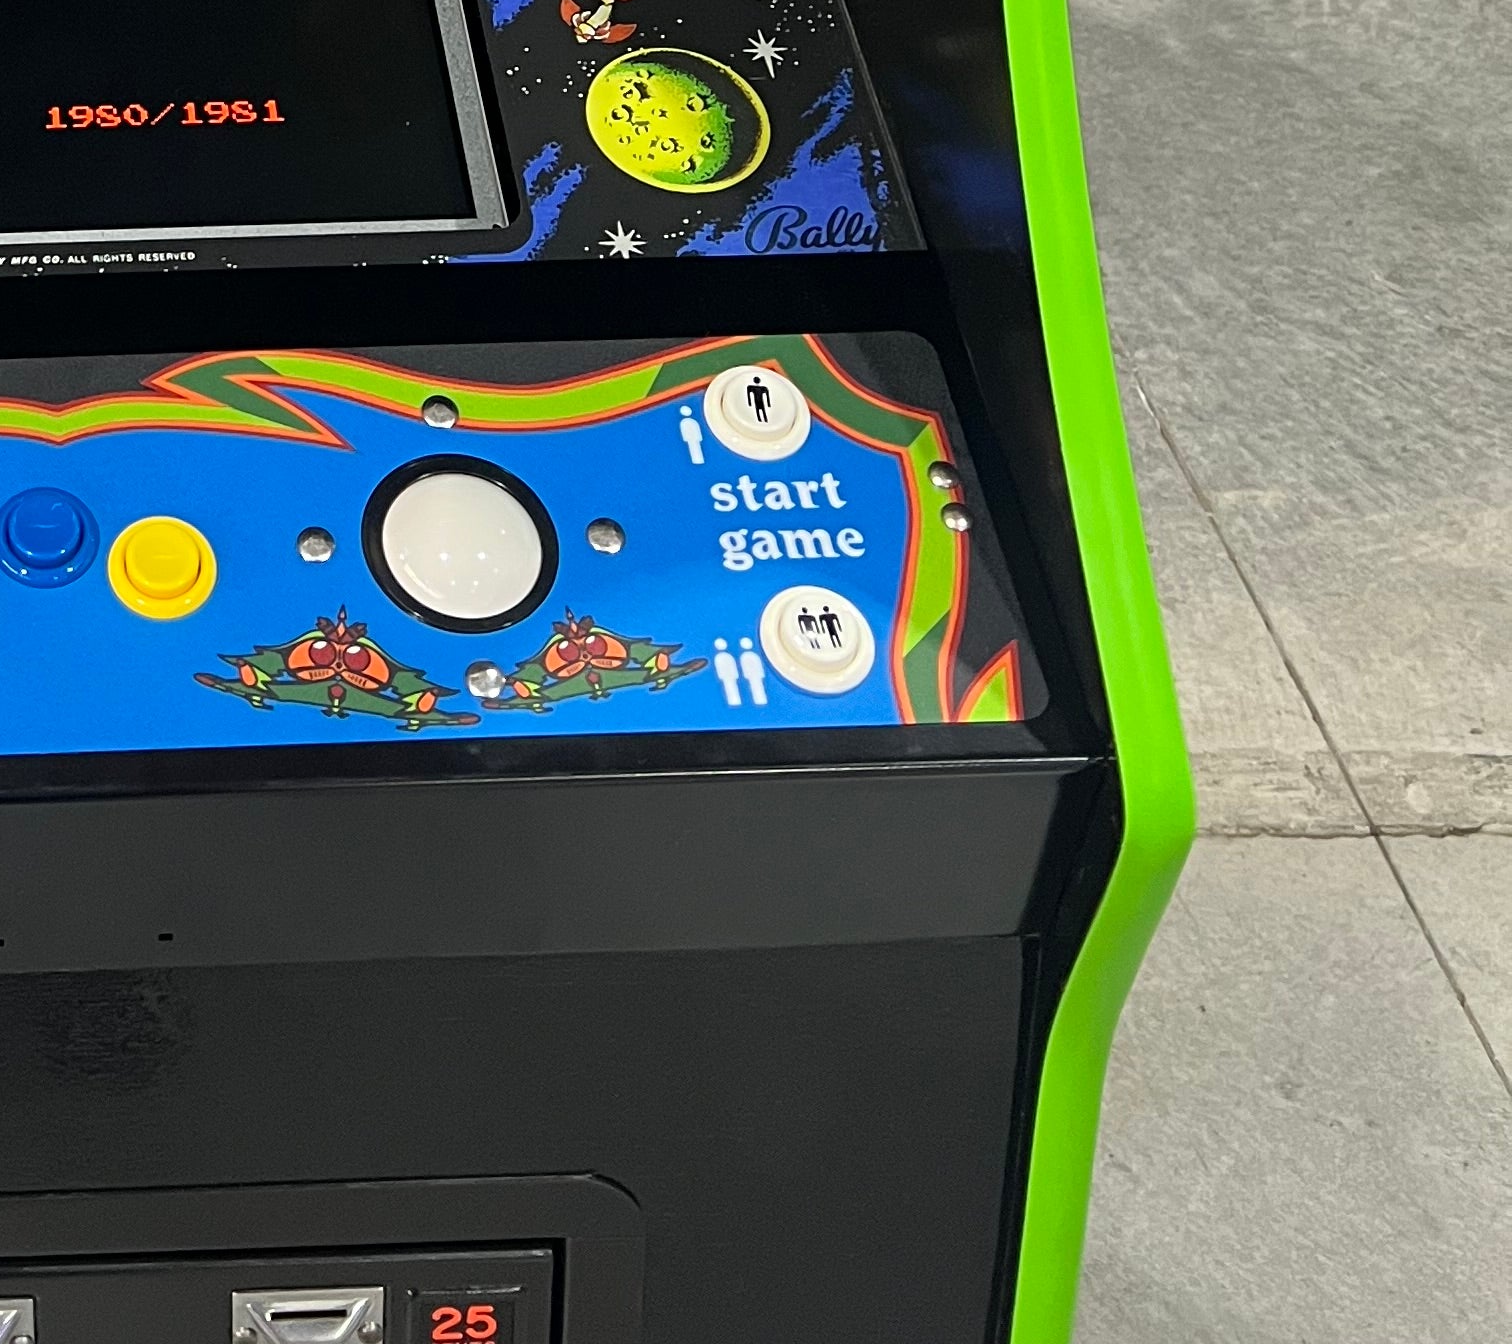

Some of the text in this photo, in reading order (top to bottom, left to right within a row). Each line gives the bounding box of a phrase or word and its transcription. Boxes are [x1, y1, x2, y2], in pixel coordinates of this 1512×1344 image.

[45, 98, 285, 131] 1980/1981
[67, 254, 88, 264] ALL
[92, 253, 134, 263] RIGHTS
[138, 251, 196, 262] RESERVED
[708, 470, 848, 512] start
[718, 522, 867, 572] game
[431, 1304, 498, 1341] 25
